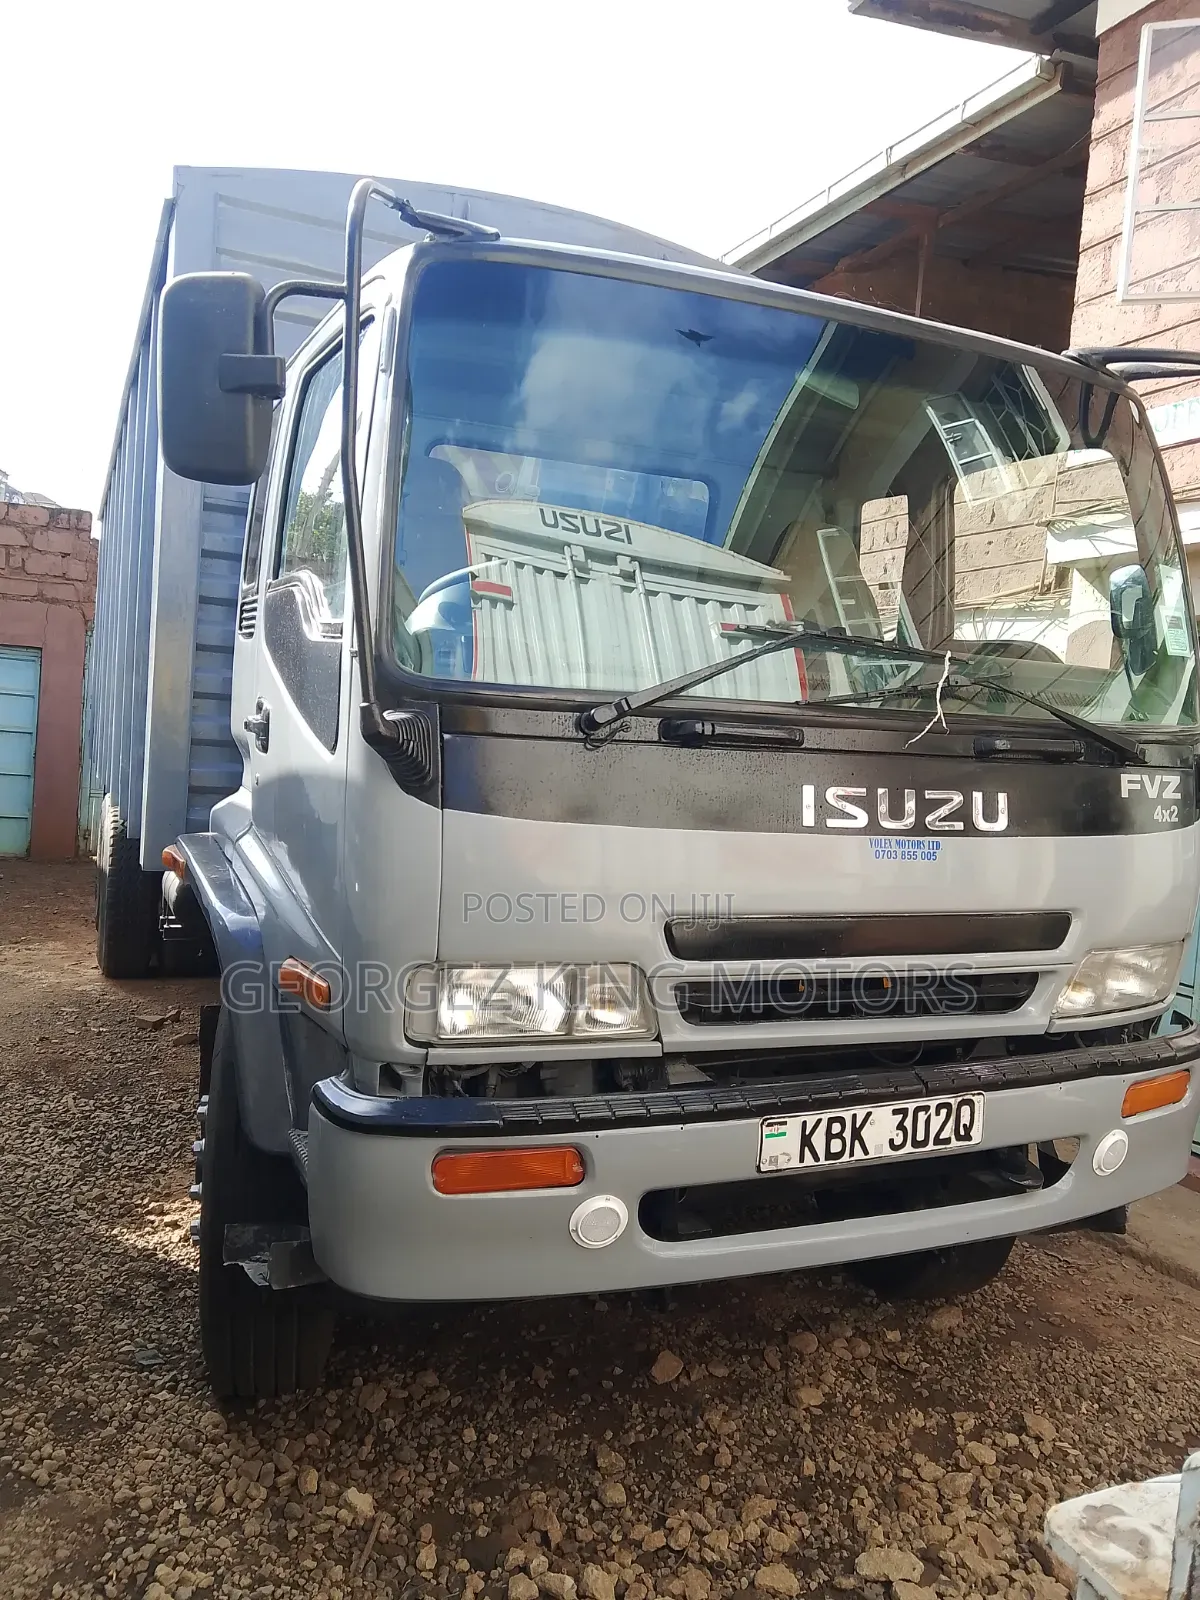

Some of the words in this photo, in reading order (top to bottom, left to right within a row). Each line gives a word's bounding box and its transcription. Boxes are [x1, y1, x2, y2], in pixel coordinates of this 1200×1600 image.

[1120, 773, 1182, 799] FVZ
[802, 784, 1009, 832] ISUZU
[1153, 804, 1179, 823] 4x2
[868, 837, 893, 849] VOLEX
[894, 838, 926, 850] MOTORS
[927, 840, 943, 851] LTD.
[874, 849, 898, 860] 0703
[900, 850, 918, 861] 855
[920, 851, 938, 861] 005
[799, 1111, 874, 1164] KBK
[888, 1098, 976, 1152] 302Q
